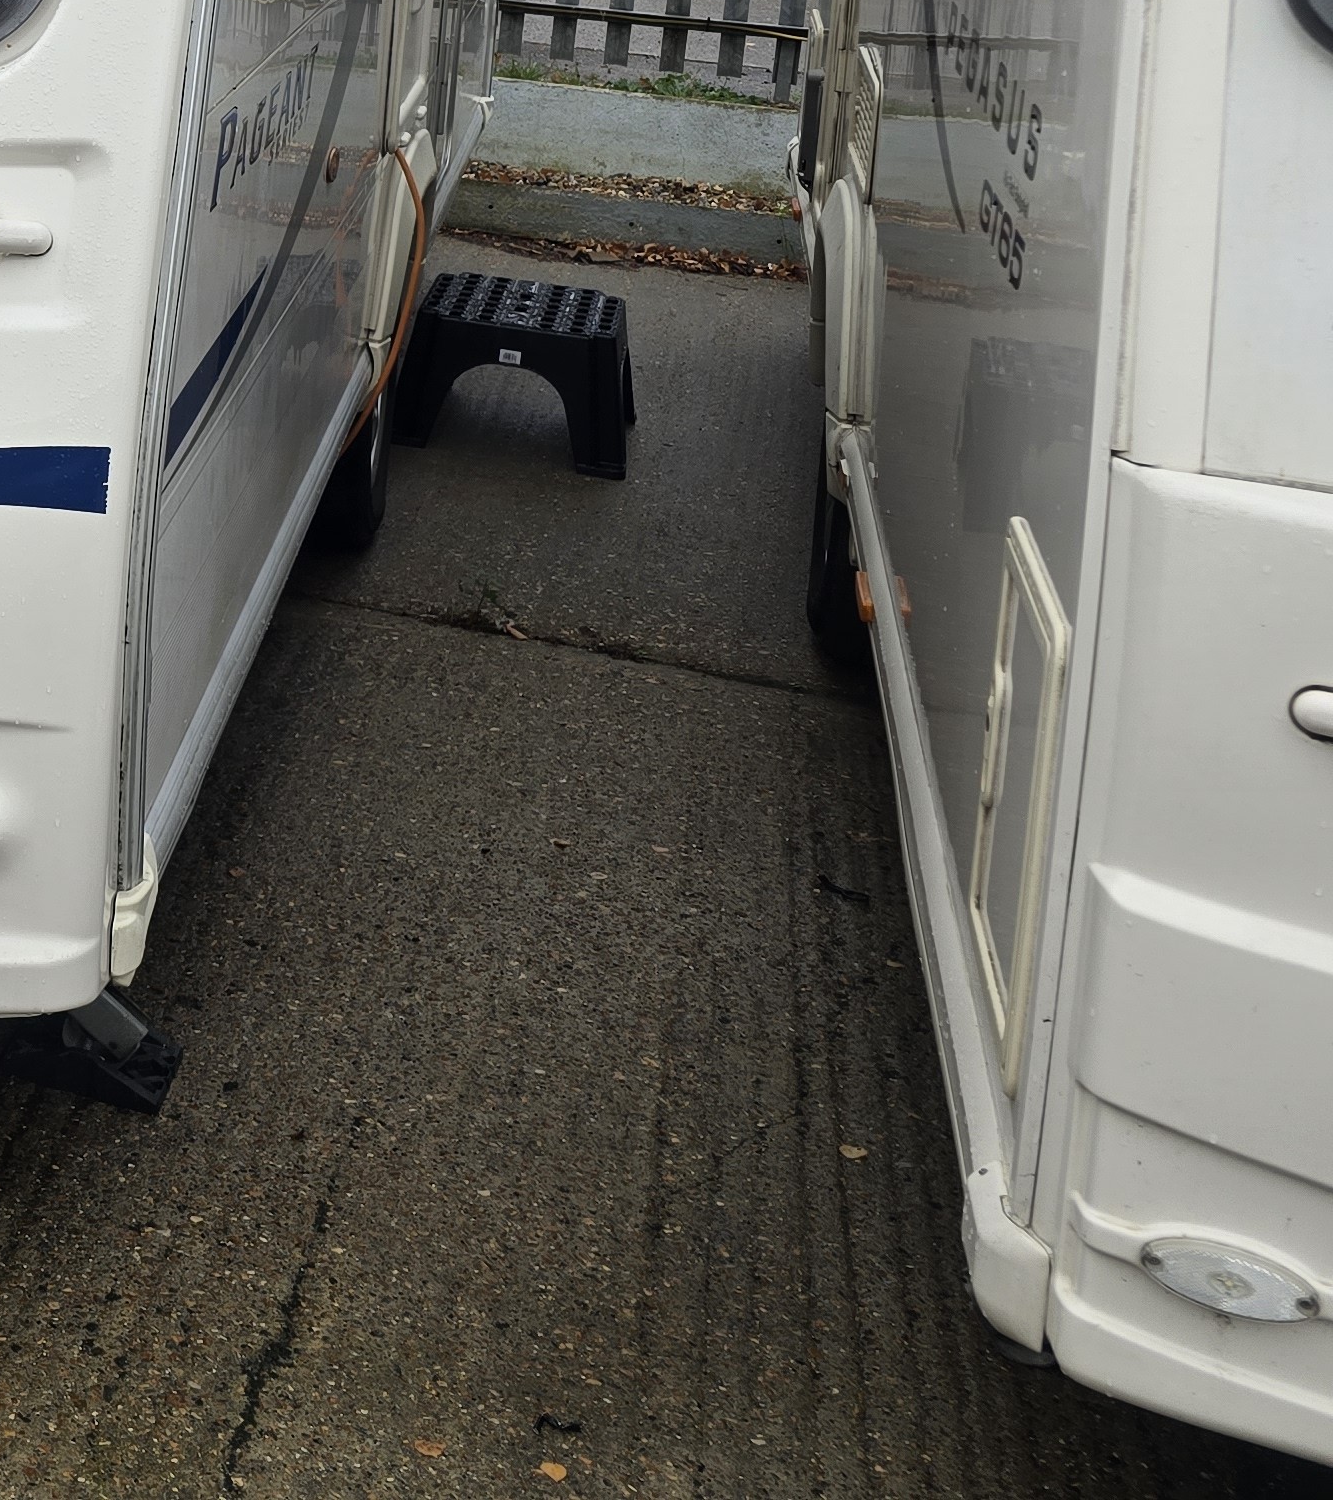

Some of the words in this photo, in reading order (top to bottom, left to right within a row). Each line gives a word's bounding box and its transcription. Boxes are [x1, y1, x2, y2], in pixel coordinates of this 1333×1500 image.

[209, 42, 319, 213] PAGEANT
[944, 0, 1043, 182] PEGASUS
[978, 178, 1026, 291] GT65
